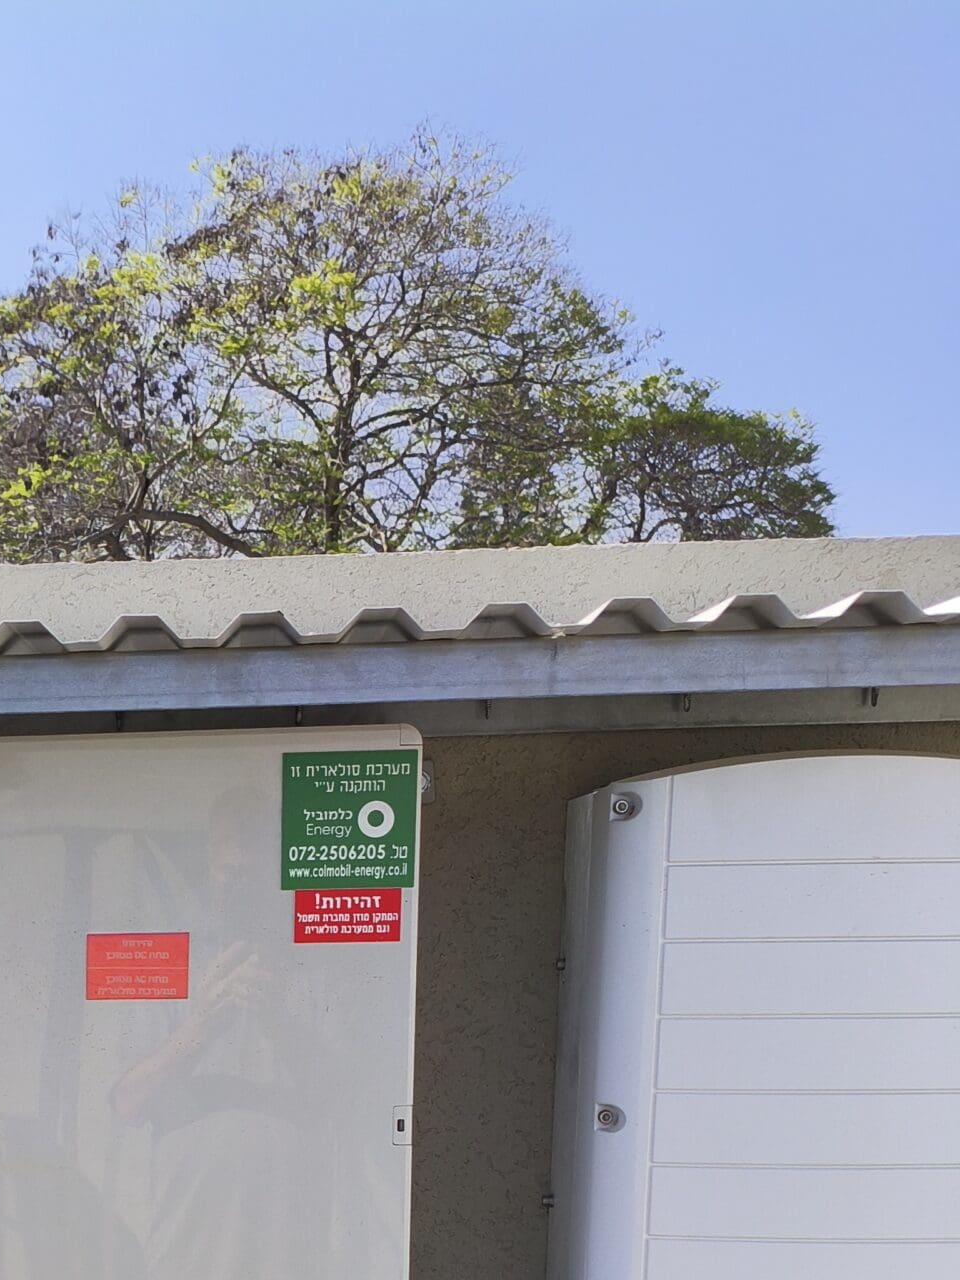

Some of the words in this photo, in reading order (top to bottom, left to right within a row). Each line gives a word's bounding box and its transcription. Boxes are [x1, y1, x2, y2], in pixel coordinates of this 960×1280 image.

[291, 766, 300, 778] זו
[305, 763, 361, 778] סולארית
[365, 763, 411, 776] מערכת
[340, 779, 386, 794] הותקנה
[303, 808, 353, 821] כלמוביל
[306, 823, 352, 838] Energy
[288, 844, 386, 861] 072-2506205
[288, 863, 408, 879] www.colmobil-energy.co.il
[314, 893, 382, 909] זהירות!
[297, 913, 320, 923] חשמל
[322, 912, 350, 922] מחברת
[372, 912, 399, 923] המתקן
[304, 924, 339, 935] סולארית
